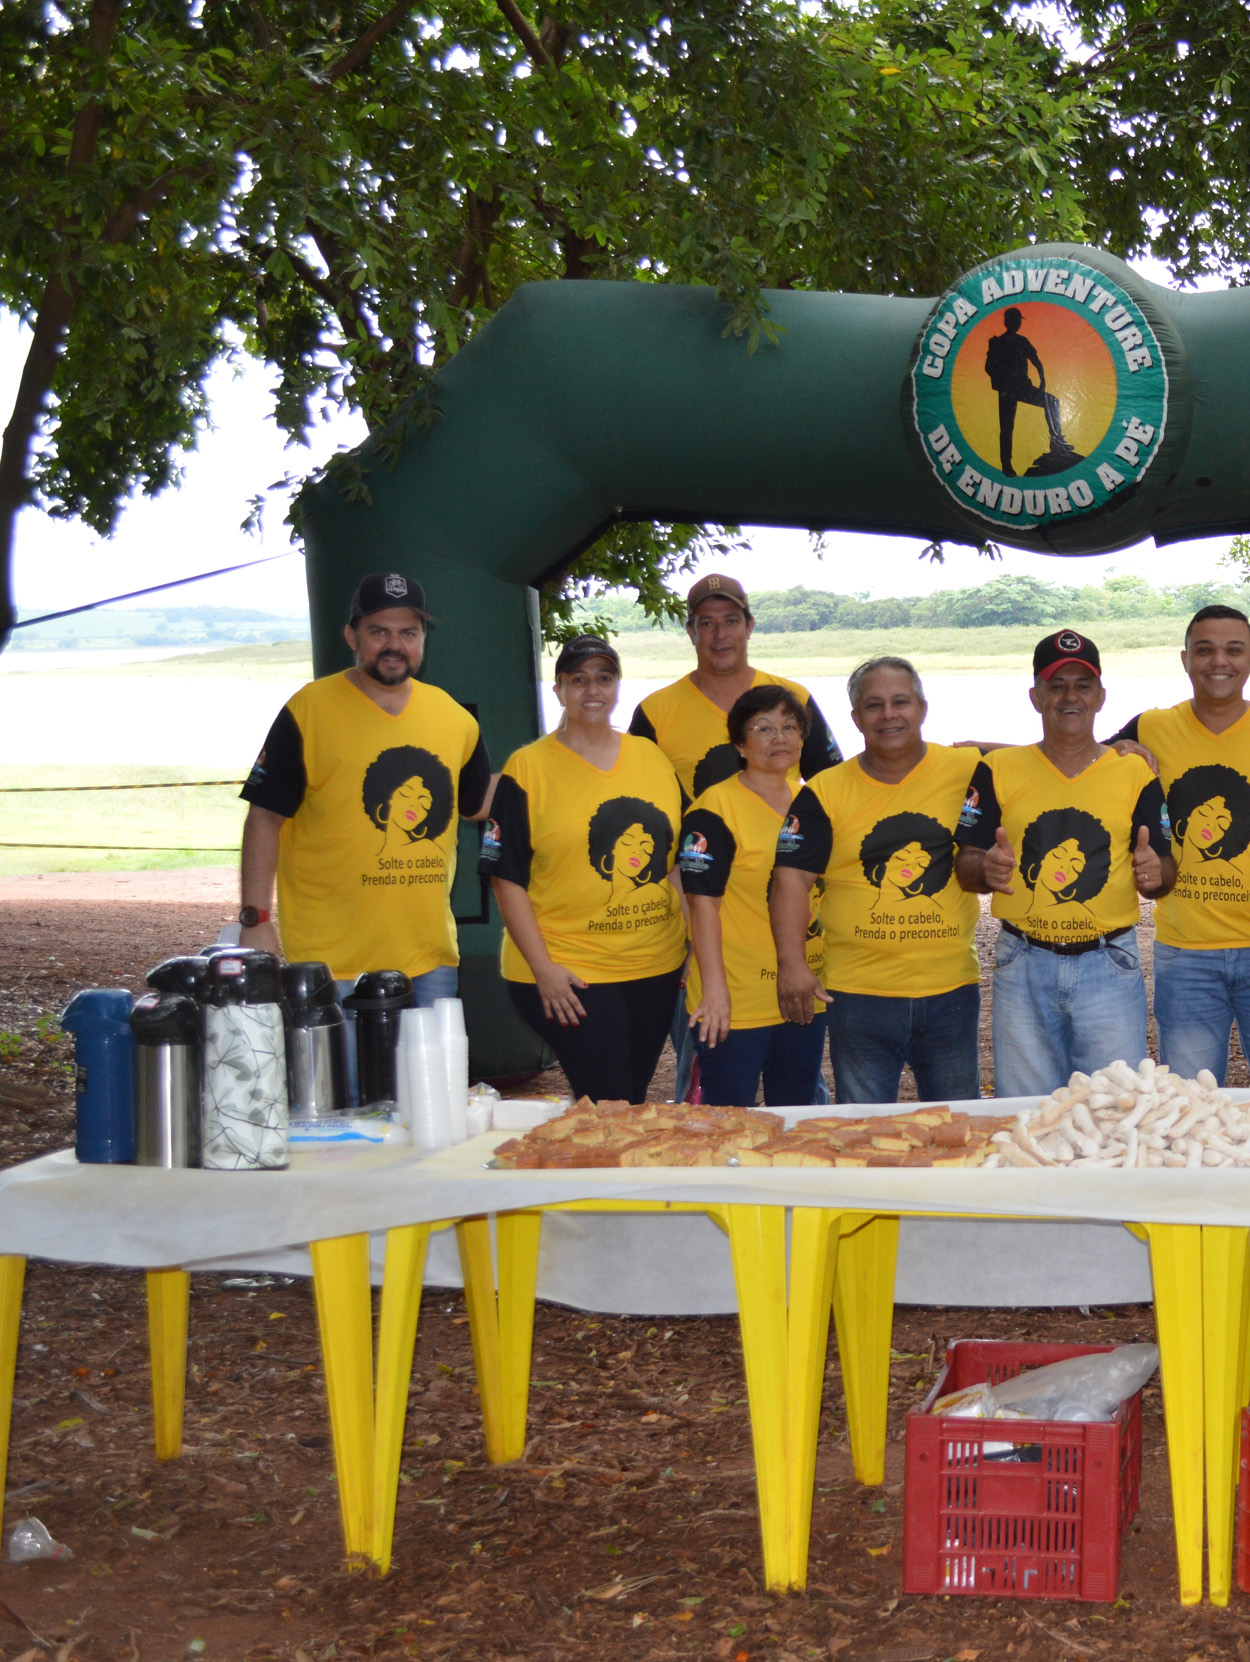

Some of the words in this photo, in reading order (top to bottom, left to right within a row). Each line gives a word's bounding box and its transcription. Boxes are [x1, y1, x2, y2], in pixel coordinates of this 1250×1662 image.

[922, 297, 978, 379] COPA
[981, 268, 1154, 375] ADVENTURE
[927, 423, 963, 475] DE
[956, 464, 1096, 516] ENDURO
[1096, 462, 1126, 493] A
[1114, 416, 1156, 467] PÉ
[378, 856, 404, 870] Solte
[406, 859, 413, 869] o
[362, 872, 397, 886] Prenda
[399, 874, 406, 885] o
[1177, 871, 1198, 885] Solte
[1200, 876, 1207, 886] o
[1209, 874, 1244, 890] cabelo,
[1194, 890, 1200, 900] o
[606, 904, 630, 917] Solte
[632, 904, 639, 914] o
[870, 912, 895, 925] Solte
[898, 915, 905, 925] o
[908, 910, 944, 925] cabelo,
[588, 918, 623, 931] Prenda
[626, 920, 632, 930] o
[1026, 916, 1049, 930] Solte
[1051, 920, 1058, 930] o
[1061, 917, 1097, 930] cabelo,
[854, 925, 886, 940] Prenda
[889, 930, 897, 940] o
[899, 923, 960, 942] preconceito!
[760, 968, 776, 980] Pre
